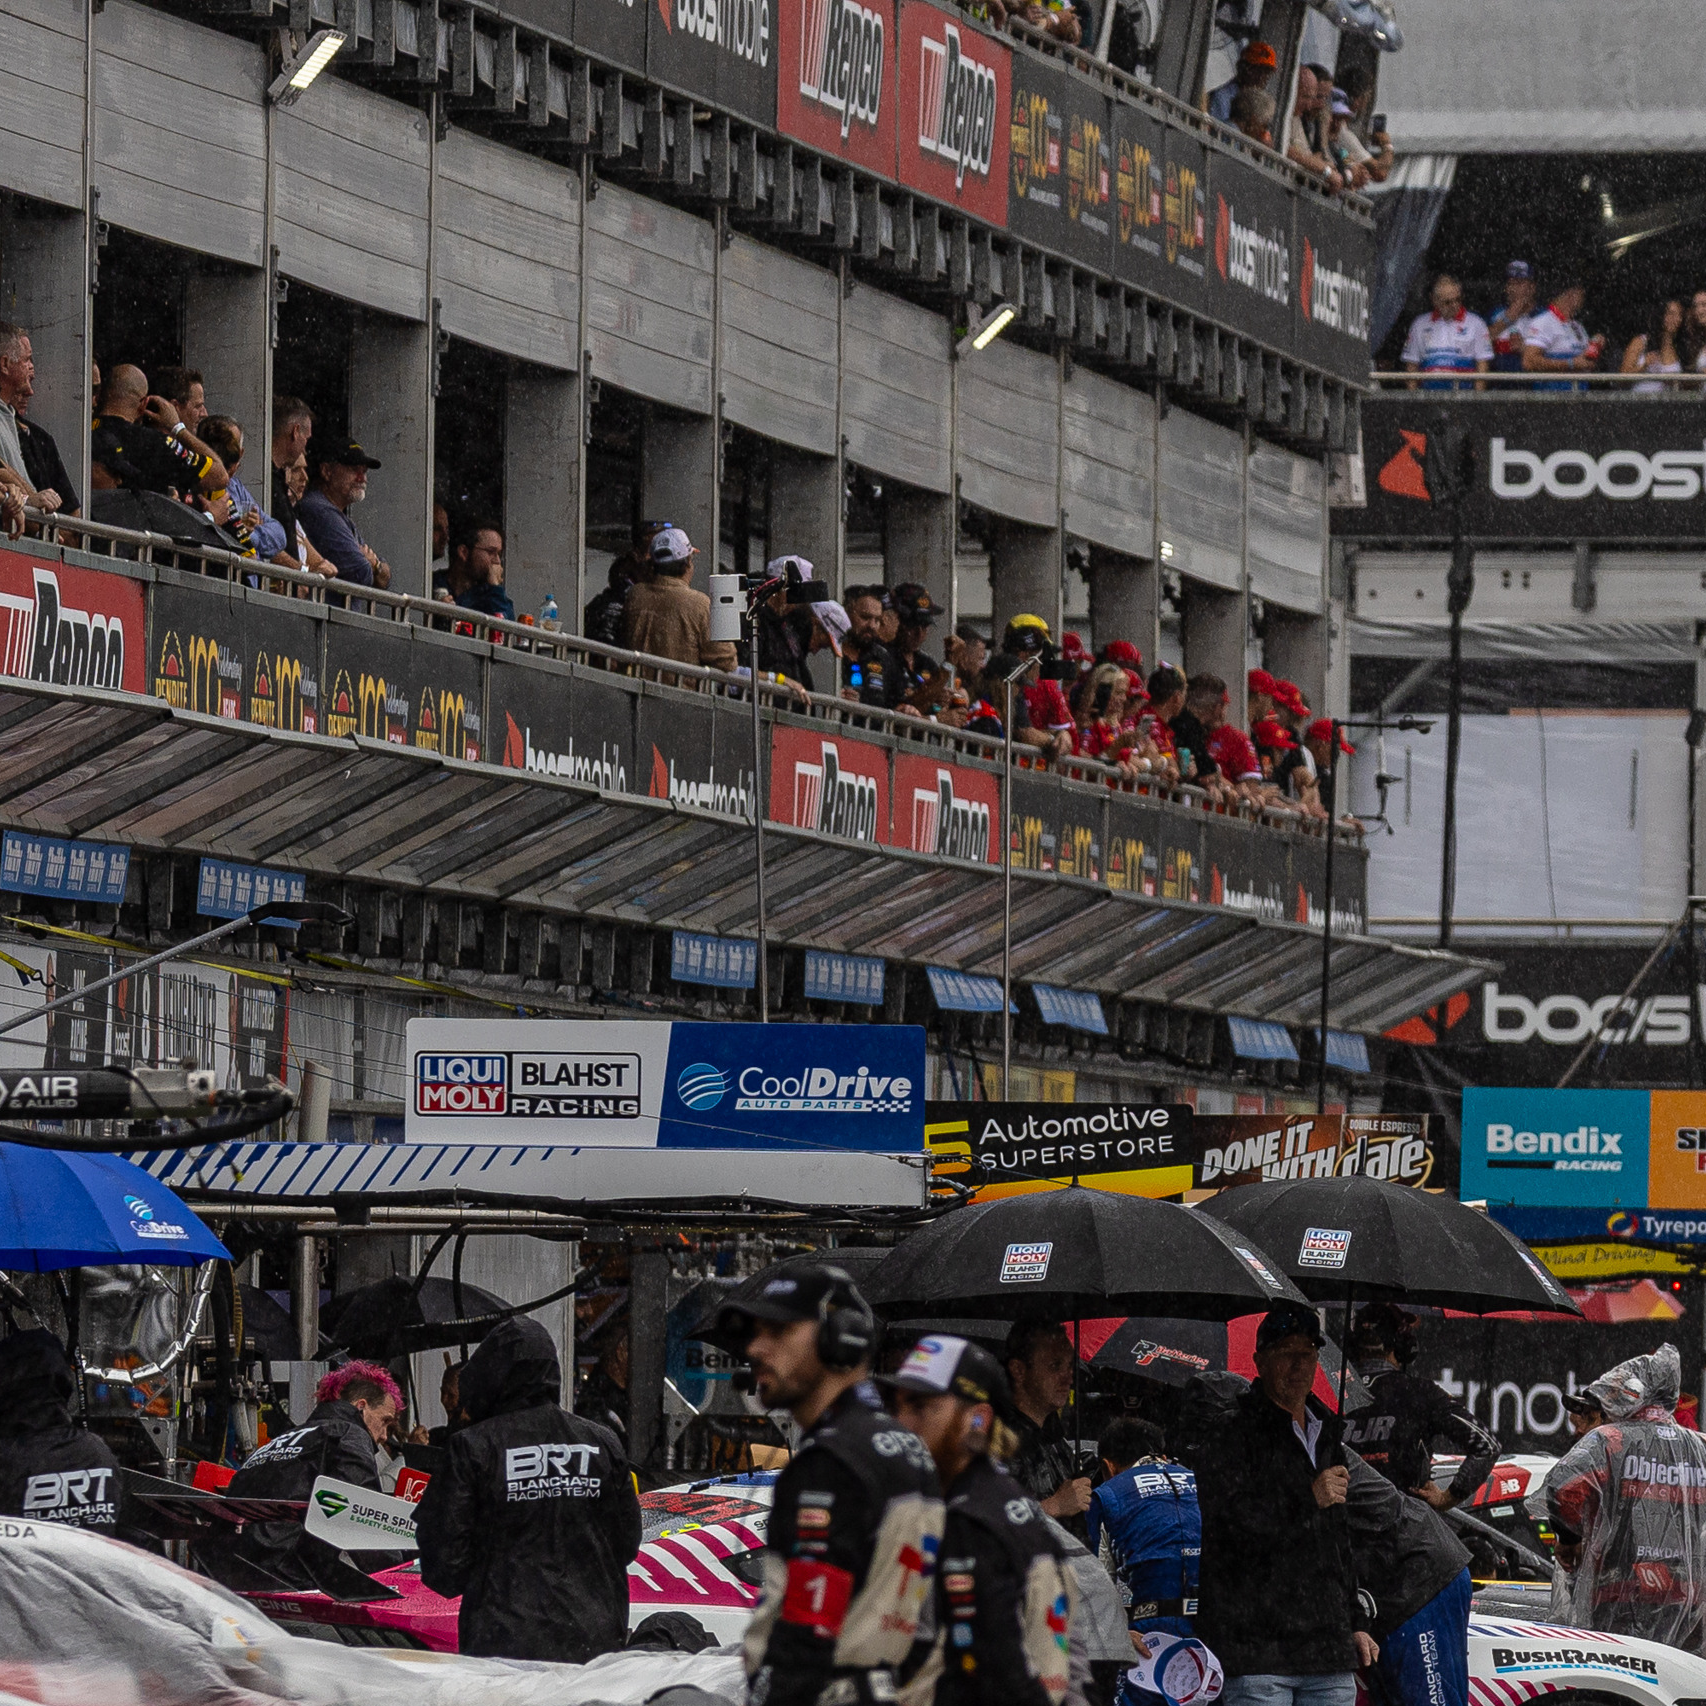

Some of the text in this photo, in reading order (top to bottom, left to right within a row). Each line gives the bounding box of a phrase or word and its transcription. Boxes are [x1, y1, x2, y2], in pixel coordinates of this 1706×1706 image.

[938, 22, 996, 188] Repco
[423, 1059, 501, 1084] LIQUI
[521, 1062, 630, 1089] BLAHST
[739, 1067, 912, 1098] CoolDrive
[10, 1077, 78, 1097] AIR
[423, 1085, 500, 1112] MOLY
[512, 1099, 638, 1114] RACING
[742, 1100, 862, 1109] AUTO PARTS
[978, 1108, 1169, 1145] Automotive
[1349, 1120, 1421, 1134] DOUBLE ESPRESSO
[1487, 1124, 1623, 1155] Bendix
[982, 1135, 1175, 1169] SUPERSTORE
[1201, 1121, 1313, 1183] DONE IT
[1263, 1145, 1335, 1180] WITH
[1342, 1135, 1426, 1180] dare
[1553, 1161, 1622, 1171] RACING
[1306, 1239, 1345, 1250] MOLY
[1309, 1230, 1347, 1241] LIQUI
[1007, 1253, 1046, 1264] MOLY
[1011, 1245, 1048, 1254] LIQUI
[506, 1444, 600, 1480] BRT
[1624, 1455, 1706, 1486] Objective
[24, 1468, 113, 1506] BRT
[507, 1477, 601, 1492] BLANCHARD
[507, 1489, 560, 1502] RACING
[351, 1505, 389, 1521] SUPER
[357, 1516, 383, 1528] SAFETY
[806, 1575, 826, 1613] 1
